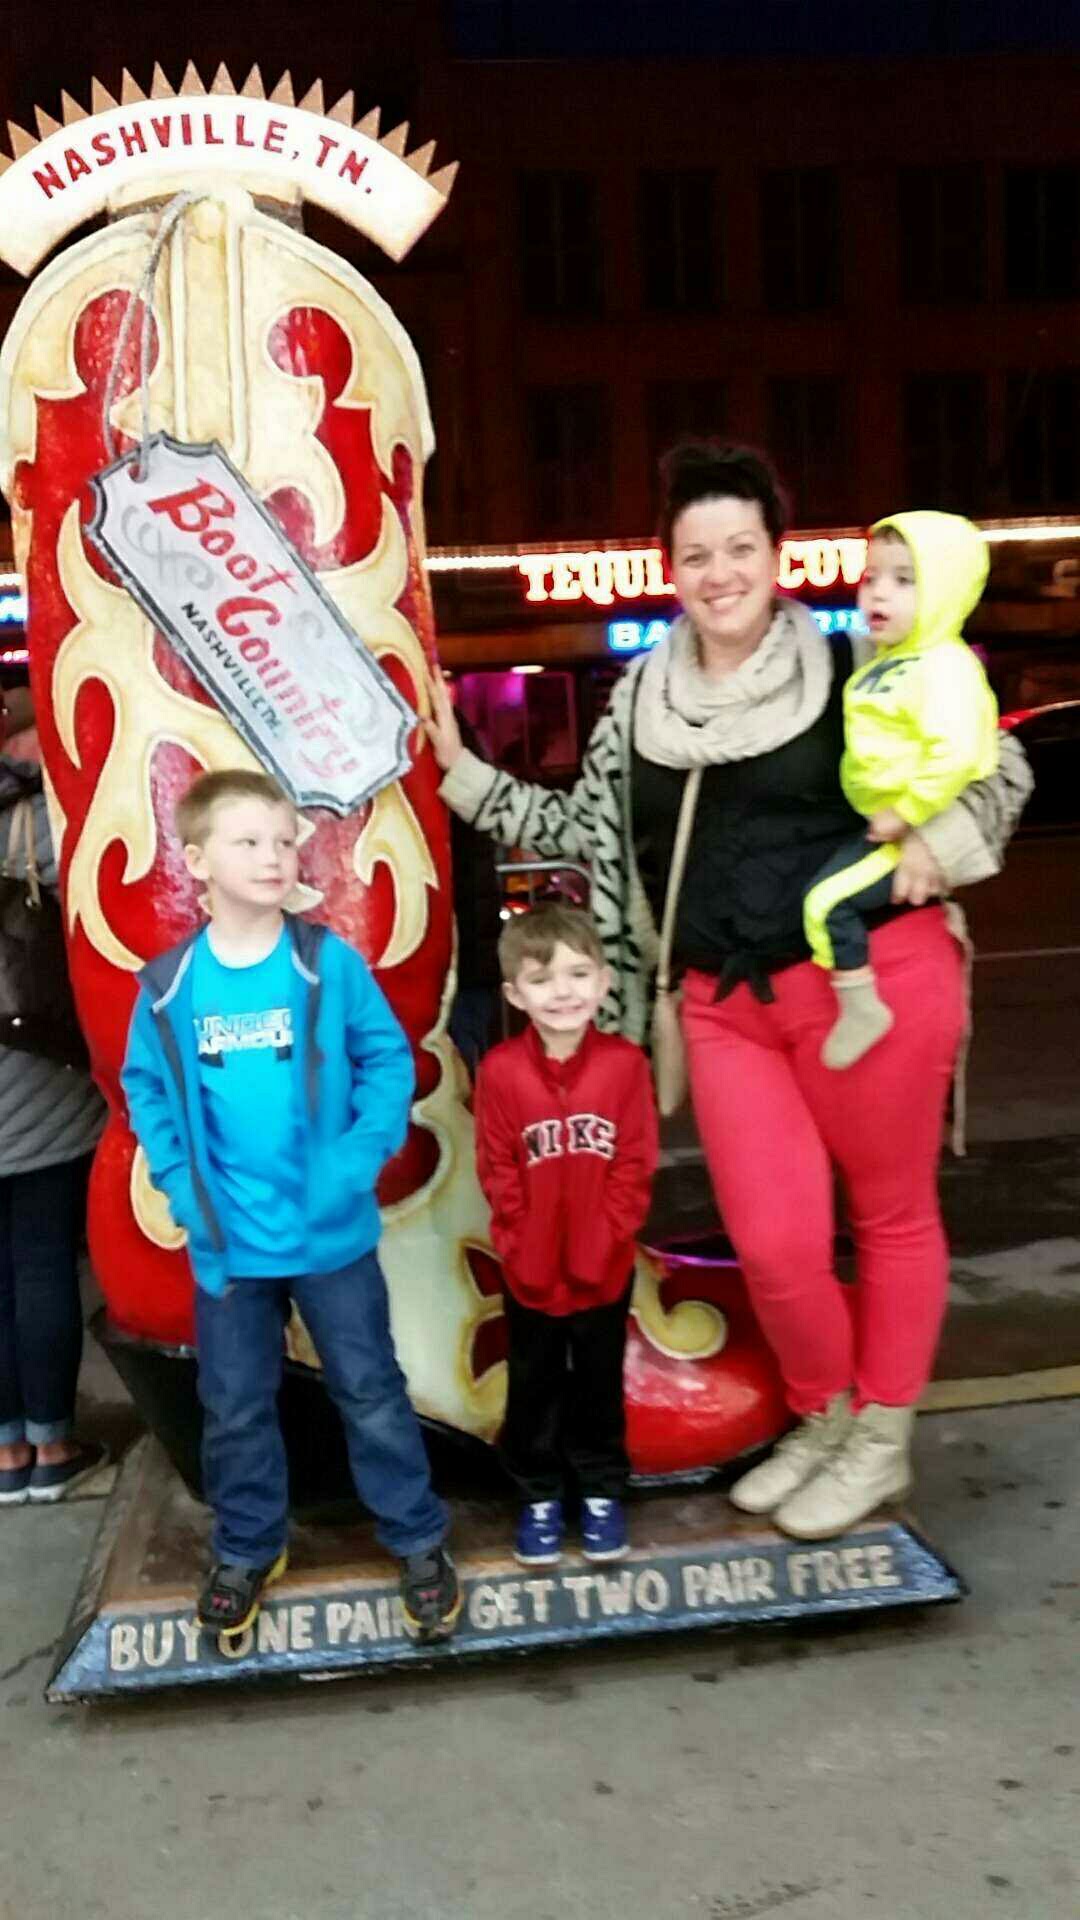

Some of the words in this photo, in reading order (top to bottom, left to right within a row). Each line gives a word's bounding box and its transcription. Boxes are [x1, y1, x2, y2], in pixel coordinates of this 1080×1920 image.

[32, 113, 301, 199] NASHVILLE,
[316, 133, 373, 195] TN.
[146, 477, 298, 594] Boot
[215, 595, 361, 780] Country
[522, 1113, 616, 1168] NIKE
[109, 1619, 201, 1671] BUY
[468, 1579, 556, 1630] GET
[562, 1568, 671, 1619] TWO
[681, 1557, 778, 1608] PAIR
[786, 1544, 904, 1597] FREE
